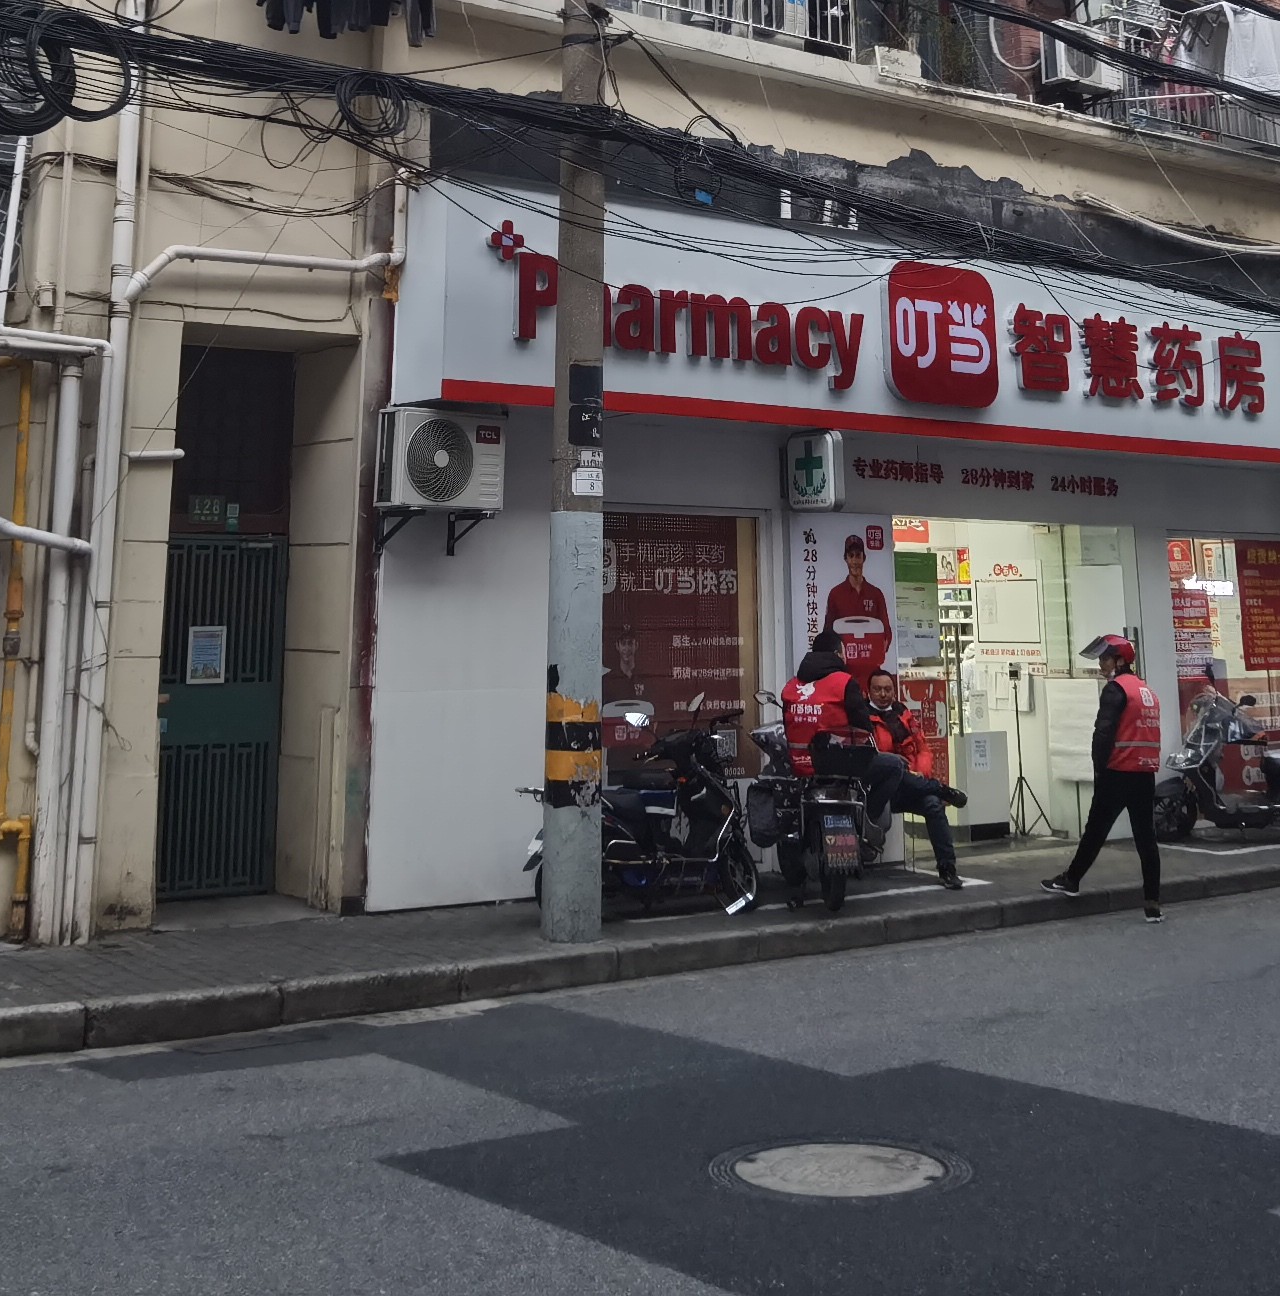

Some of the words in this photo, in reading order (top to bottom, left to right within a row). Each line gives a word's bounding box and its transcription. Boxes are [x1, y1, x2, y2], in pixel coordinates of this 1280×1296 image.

[515, 252, 864, 390] Parmacy
[895, 296, 992, 375] 叮当
[1010, 303, 1266, 414] 智慧药房
[480, 431, 497, 439] TCL
[853, 456, 944, 484] 专业药师指导
[961, 467, 1034, 491] 28分钟到家
[1051, 475, 1118, 497] 24小时服务
[620, 567, 737, 594] 就上叮当快药
